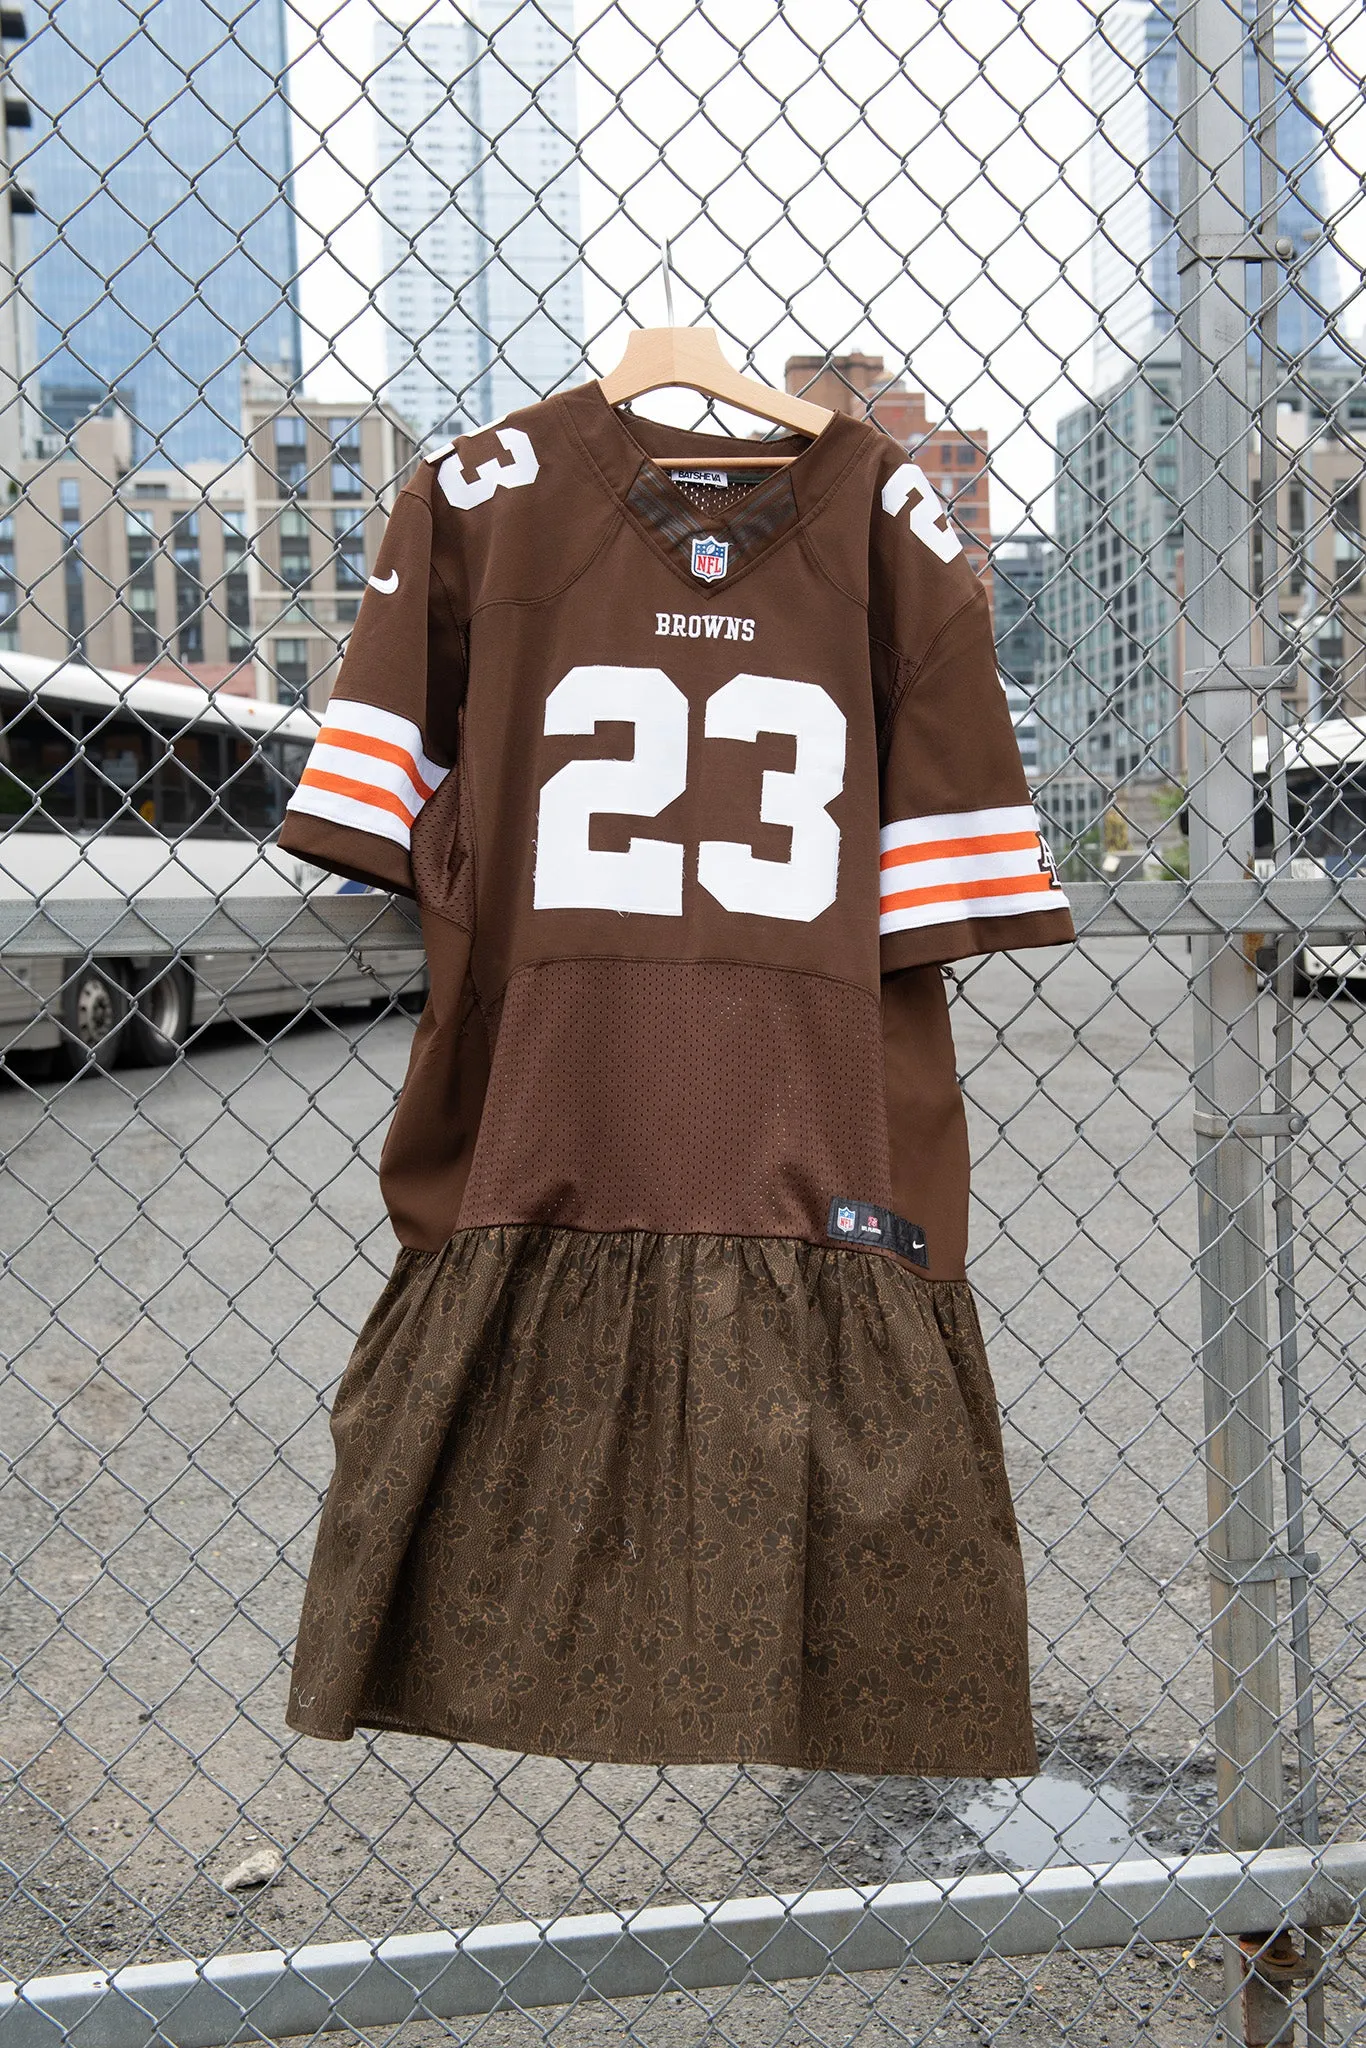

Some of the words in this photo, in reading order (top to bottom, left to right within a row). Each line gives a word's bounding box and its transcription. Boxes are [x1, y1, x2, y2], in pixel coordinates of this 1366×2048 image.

[424, 415, 540, 511] 3
[678, 470, 722, 482] BATSHEVA
[697, 555, 722, 575] NFL
[655, 613, 756, 642] BROWNS
[533, 664, 848, 923] 23
